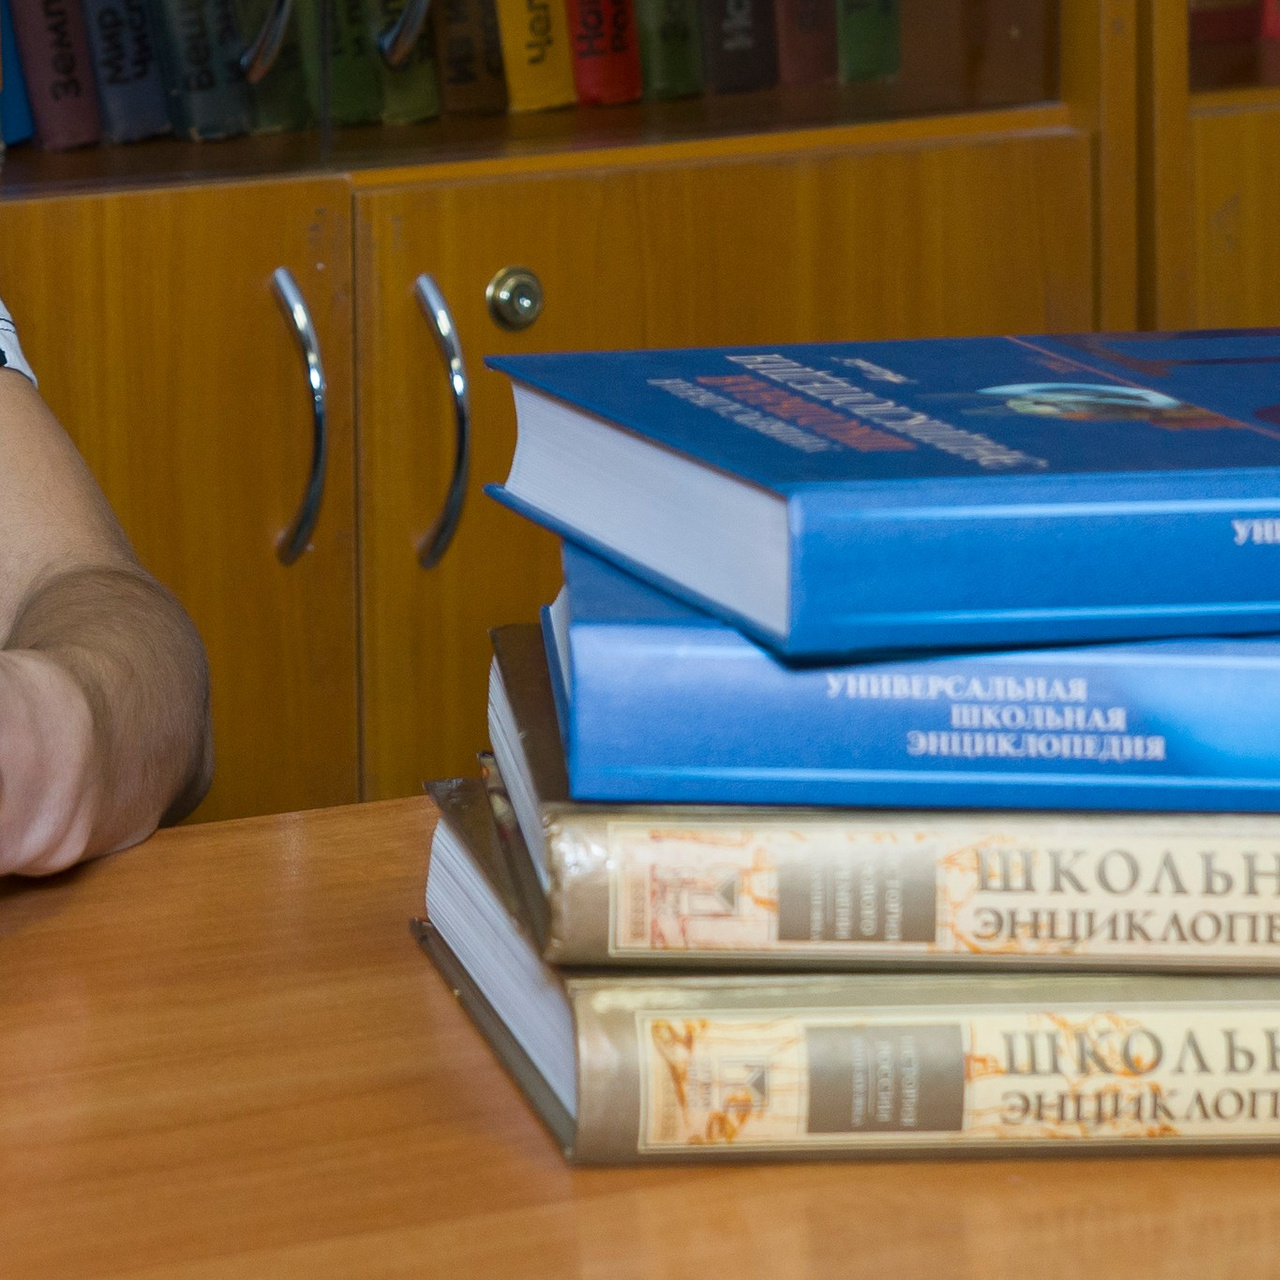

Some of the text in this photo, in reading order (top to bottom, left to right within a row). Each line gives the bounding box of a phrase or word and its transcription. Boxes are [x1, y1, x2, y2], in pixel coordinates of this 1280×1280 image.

[96, 5, 130, 88] Мир
[826, 673, 1088, 704] УНИВЕРСАЛЬНАЯ
[950, 703, 1127, 732] ШКОЛЬНАЯ
[906, 730, 1167, 762] ЭНЦИКЛОПЕДИЯ
